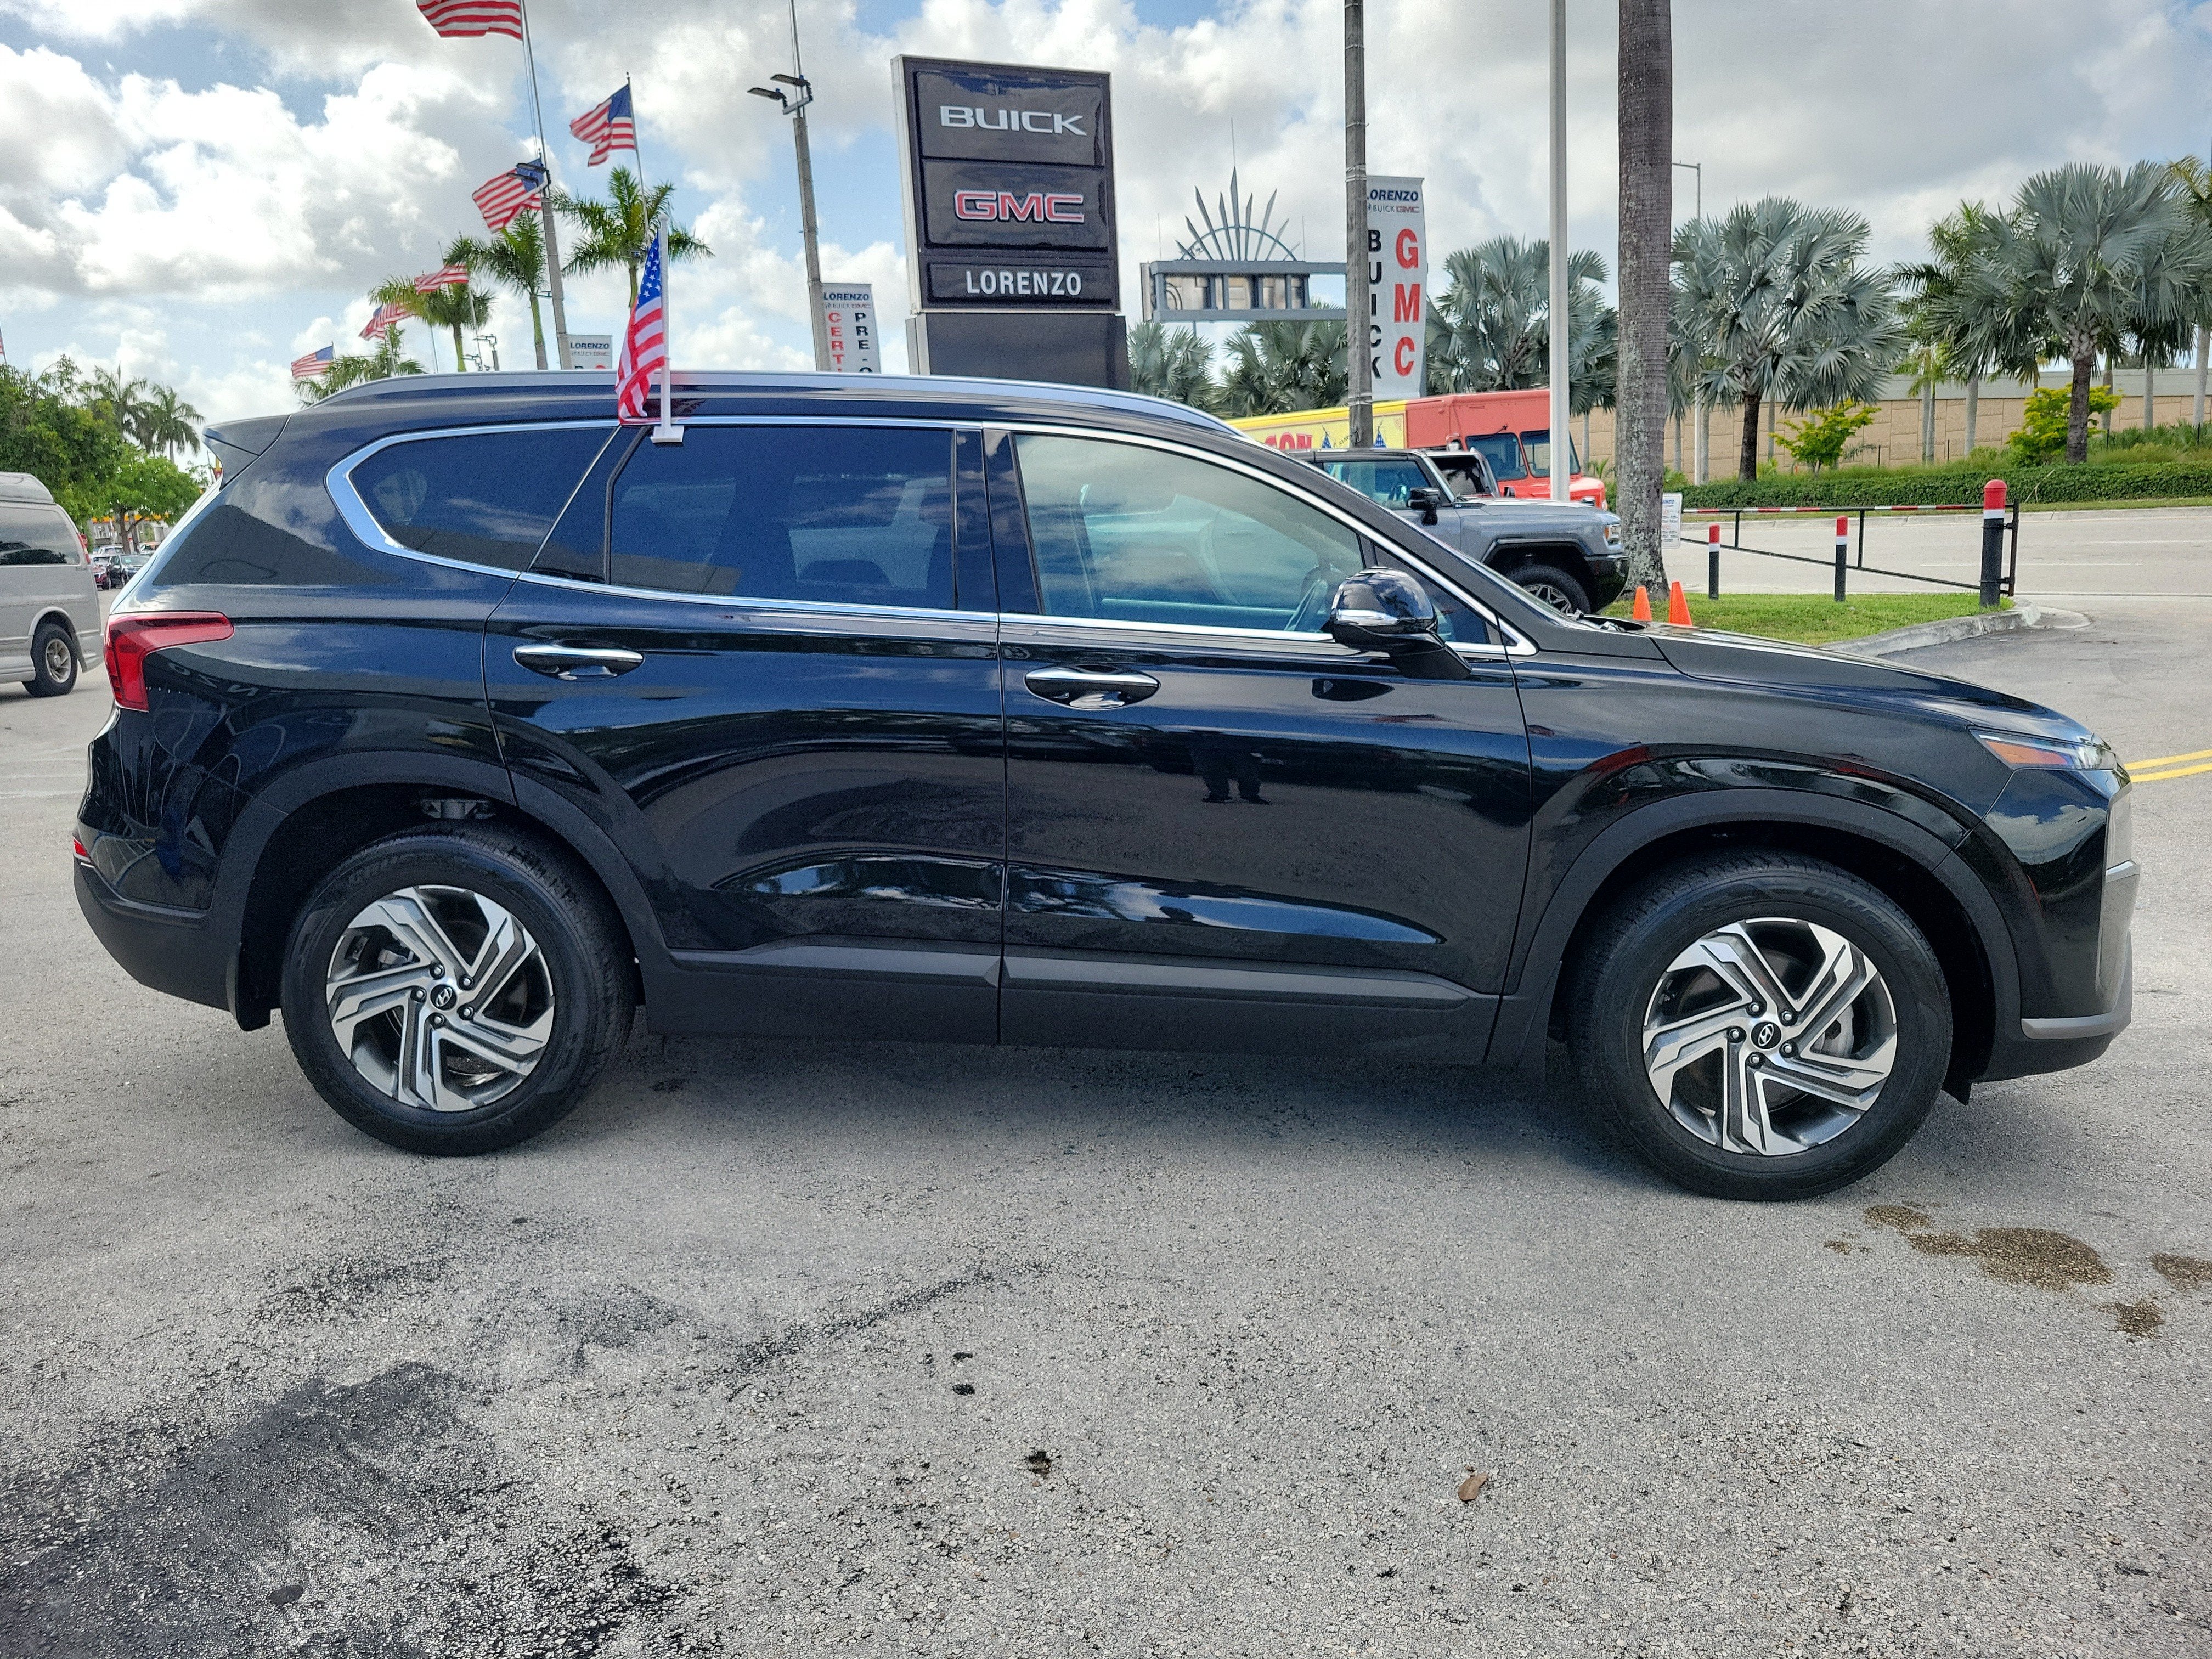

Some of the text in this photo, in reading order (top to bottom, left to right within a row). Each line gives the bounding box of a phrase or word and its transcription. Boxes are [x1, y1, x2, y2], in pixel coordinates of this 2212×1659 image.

[940, 105, 1087, 136] BUICK
[953, 189, 1085, 223] GMC
[1367, 189, 1419, 201] ORENZO
[966, 270, 1082, 296] LORENZO
[1394, 228, 1420, 377] GMC
